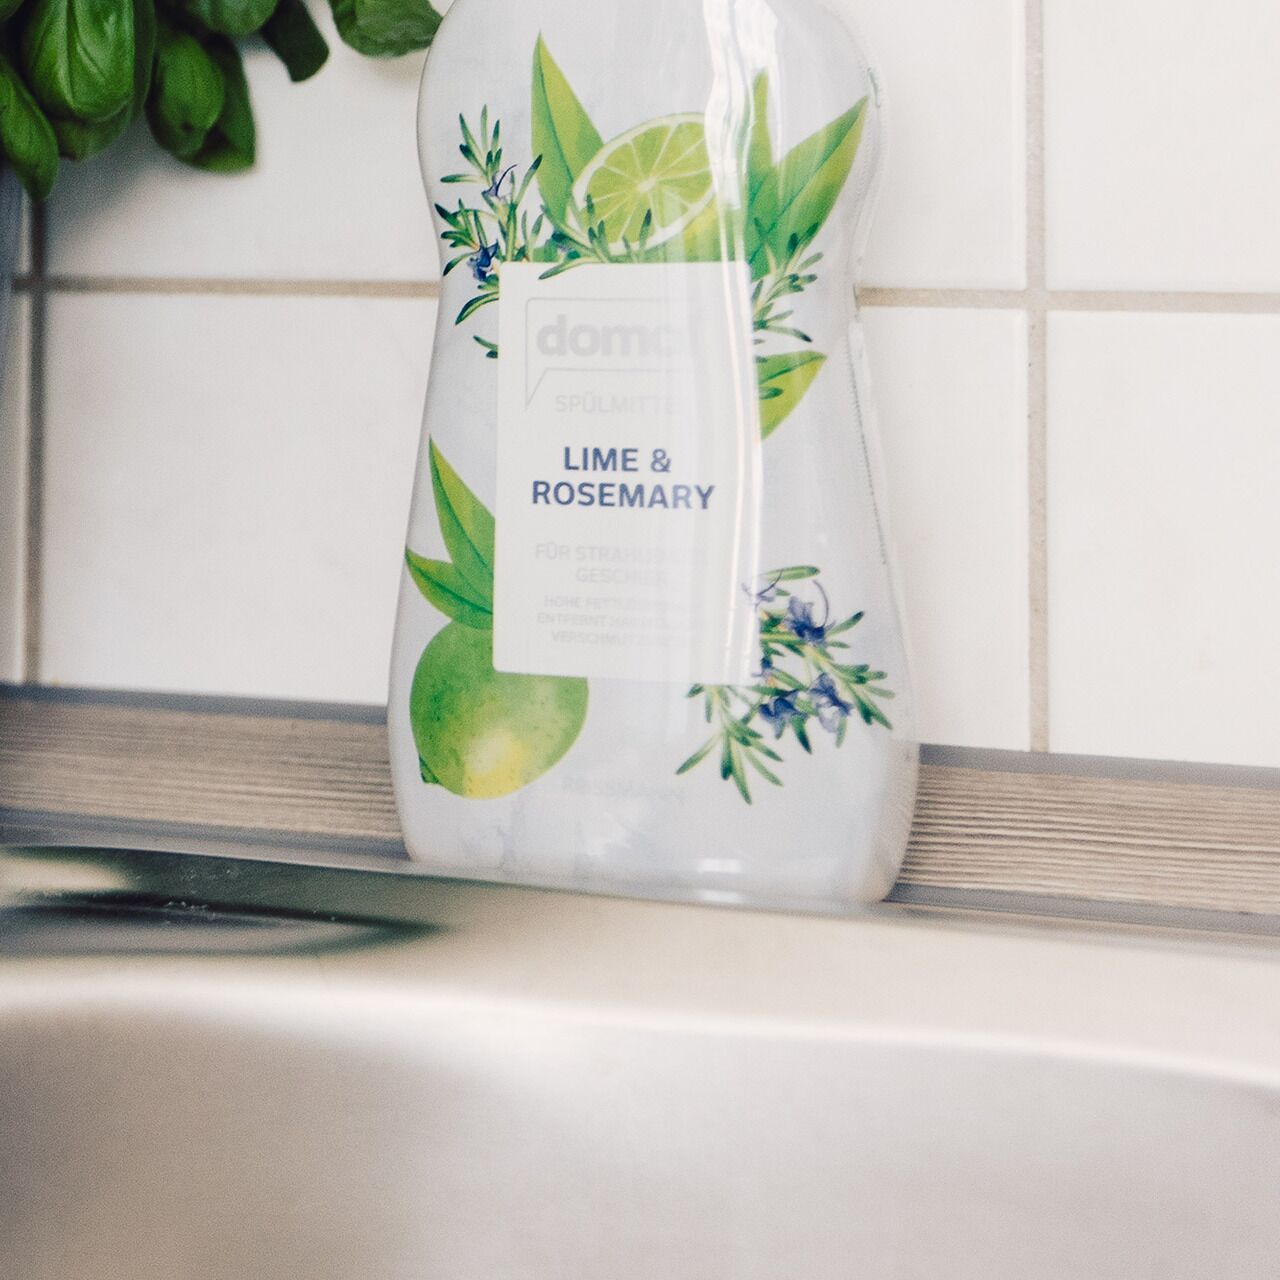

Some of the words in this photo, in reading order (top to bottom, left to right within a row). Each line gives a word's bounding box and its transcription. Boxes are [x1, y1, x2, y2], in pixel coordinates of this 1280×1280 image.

[563, 446, 640, 472] LIME
[649, 448, 672, 473] &
[532, 479, 716, 510] ROSEMARY
